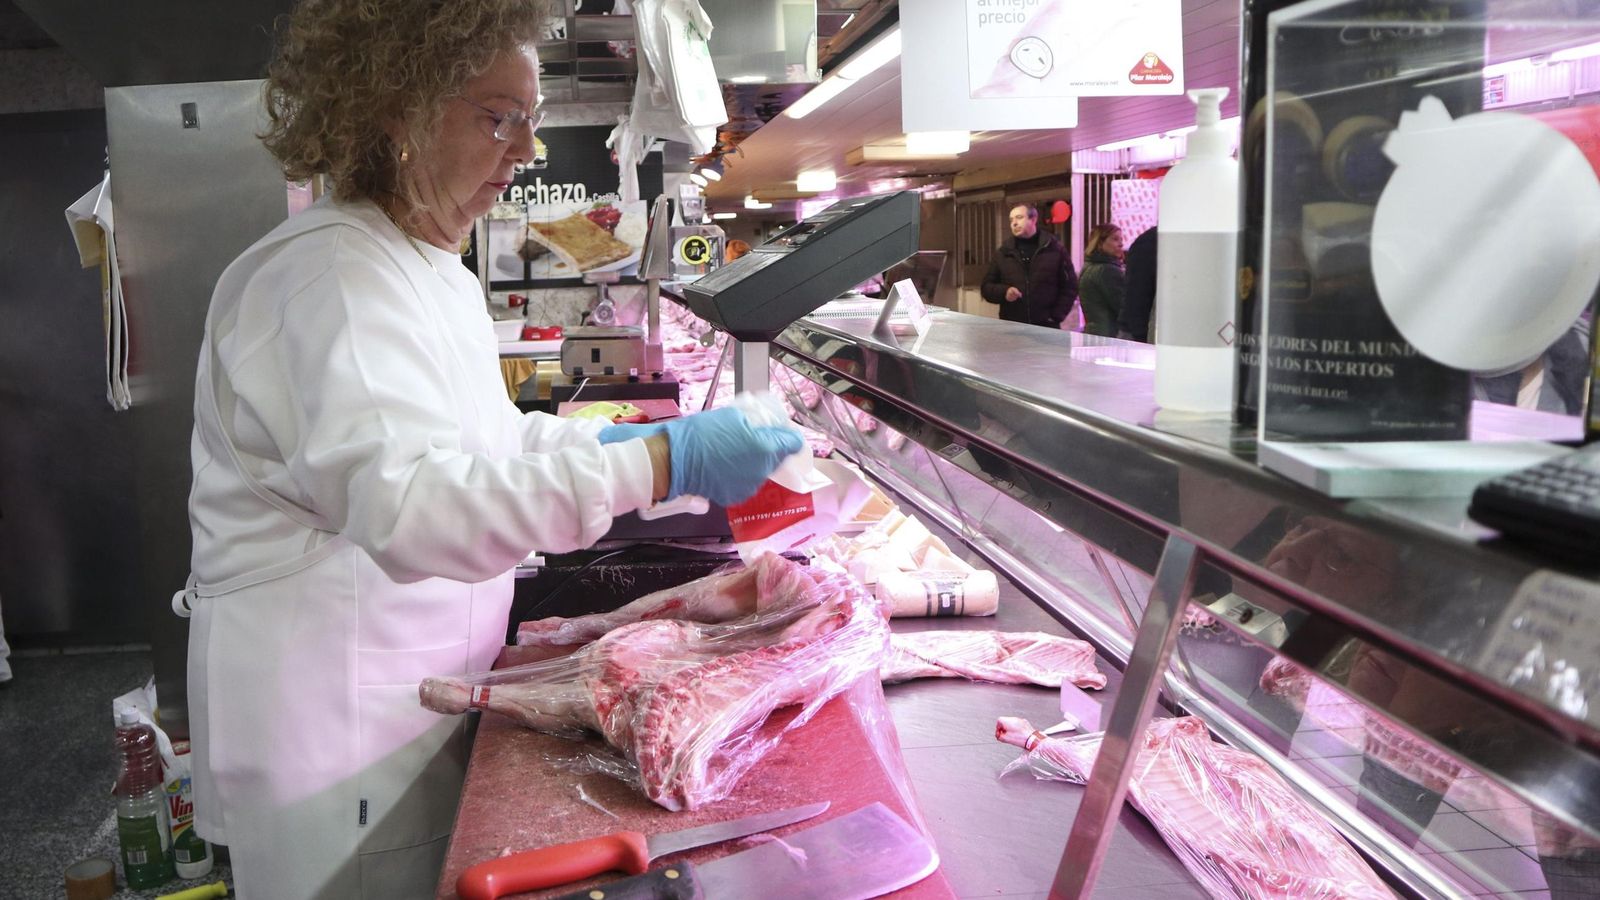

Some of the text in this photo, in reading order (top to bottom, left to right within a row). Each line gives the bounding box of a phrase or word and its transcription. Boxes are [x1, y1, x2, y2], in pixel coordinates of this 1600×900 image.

[979, 9, 1026, 28] precio
[1321, 339, 1355, 354] DEL
[1359, 341, 1417, 357] MUND
[1276, 356, 1301, 370] LOS
[1304, 358, 1395, 377] EXPERTOS
